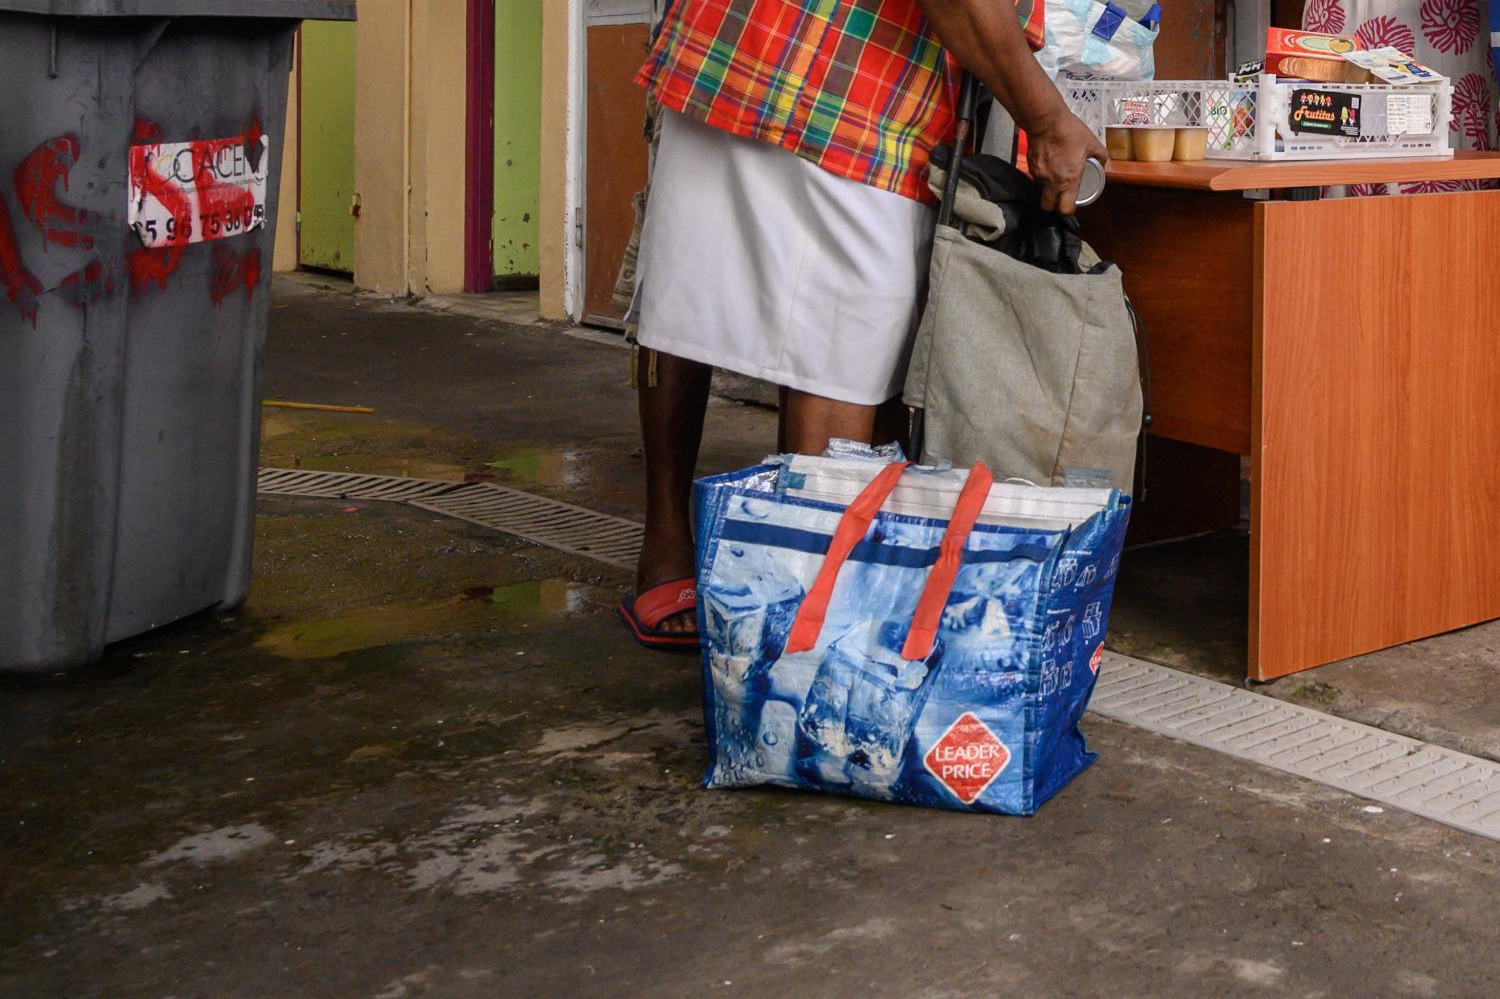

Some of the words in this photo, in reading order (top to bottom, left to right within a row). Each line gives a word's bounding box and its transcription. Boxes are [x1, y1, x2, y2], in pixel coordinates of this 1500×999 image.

[1294, 105, 1335, 121] Frutitas
[935, 744, 1000, 762] LEADER
[942, 763, 991, 779] PRICE
